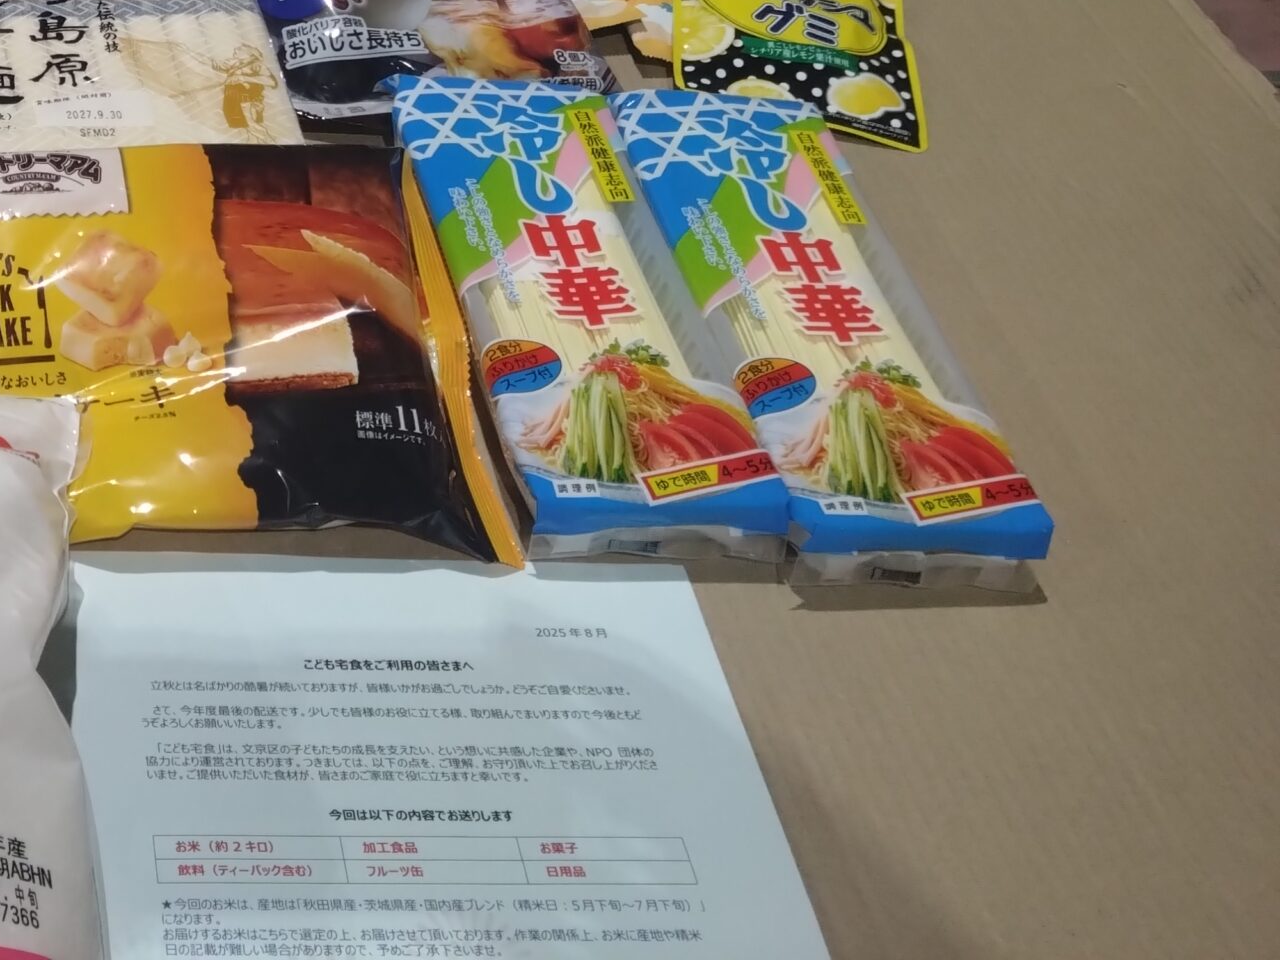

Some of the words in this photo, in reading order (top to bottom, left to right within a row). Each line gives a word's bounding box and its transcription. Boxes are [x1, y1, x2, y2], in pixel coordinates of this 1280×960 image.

[286, 17, 366, 40] 酸化バリア容器
[752, 2, 838, 47] グミ
[287, 28, 422, 60] おいしさ長持ち
[555, 51, 594, 65] 8個入
[65, 109, 124, 121] 2027.9.30
[573, 109, 630, 201] 自然派健康志向
[795, 131, 862, 224] 自然派健康志向
[484, 340, 523, 360] 2食分
[492, 353, 539, 378] ふりかけ
[736, 359, 776, 385] 2食分
[500, 367, 554, 390] スープ付
[744, 371, 793, 402] ふりかけ
[755, 384, 806, 414] スープ付
[354, 404, 438, 440] 標準11枚
[556, 478, 598, 497] 調理例
[655, 468, 713, 494] ゆで時間
[824, 499, 865, 514] 調理例
[919, 492, 976, 515] ゆで時間
[303, 658, 474, 672] こども宅食をご利用の皆さまへ
[142, 718, 283, 730] うぞよろしくお願いいたします。
[329, 808, 513, 822] 今回は以下の内容でお送りします
[363, 841, 419, 855] 加工食品
[539, 842, 579, 855] お菓子
[365, 865, 425, 878] フルーツ缶
[546, 865, 588, 879] 日用品
[161, 913, 222, 926] になります。
